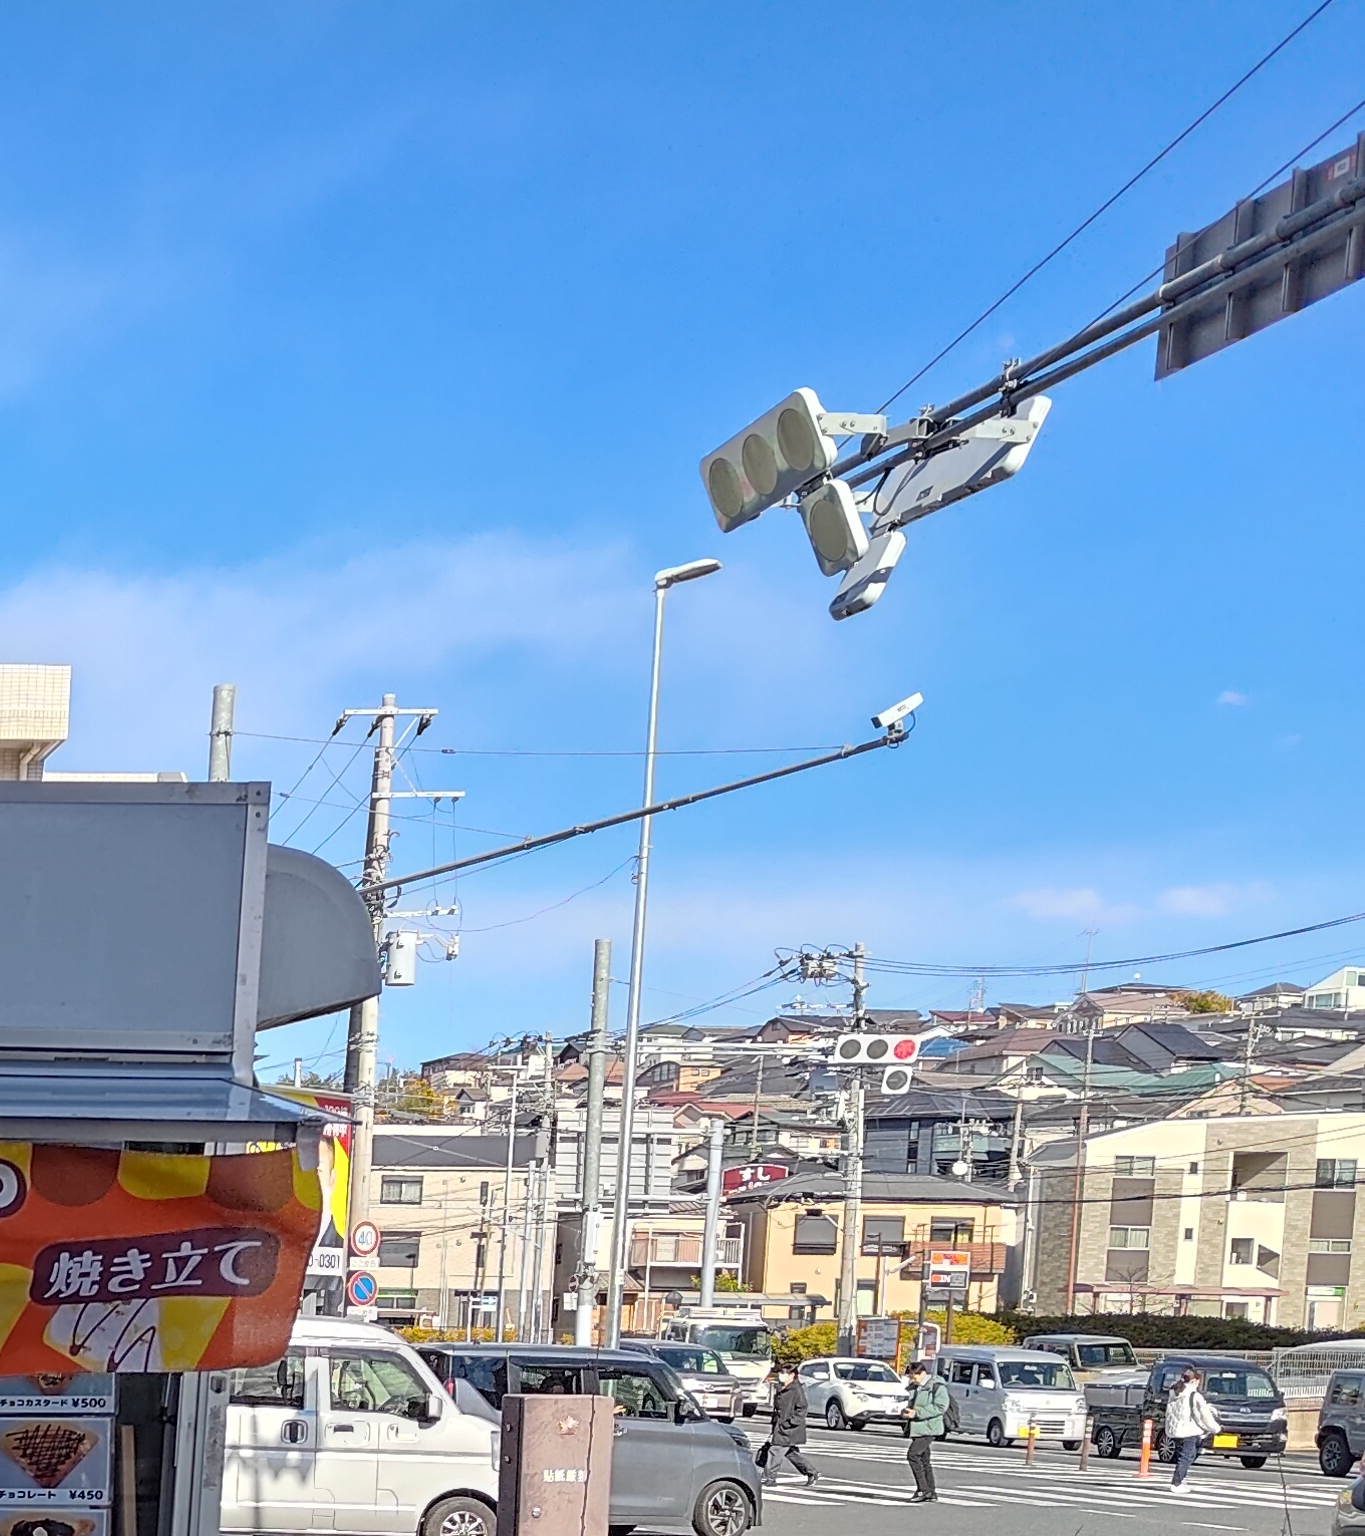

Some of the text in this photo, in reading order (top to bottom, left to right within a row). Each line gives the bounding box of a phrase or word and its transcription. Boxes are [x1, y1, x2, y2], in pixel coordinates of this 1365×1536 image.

[739, 1167, 771, 1181] すし
[43, 1240, 262, 1298] 焼き立て
[0, 1398, 106, 1408] チョコカスタード ¥500
[69, 1490, 103, 1500] ¥450
